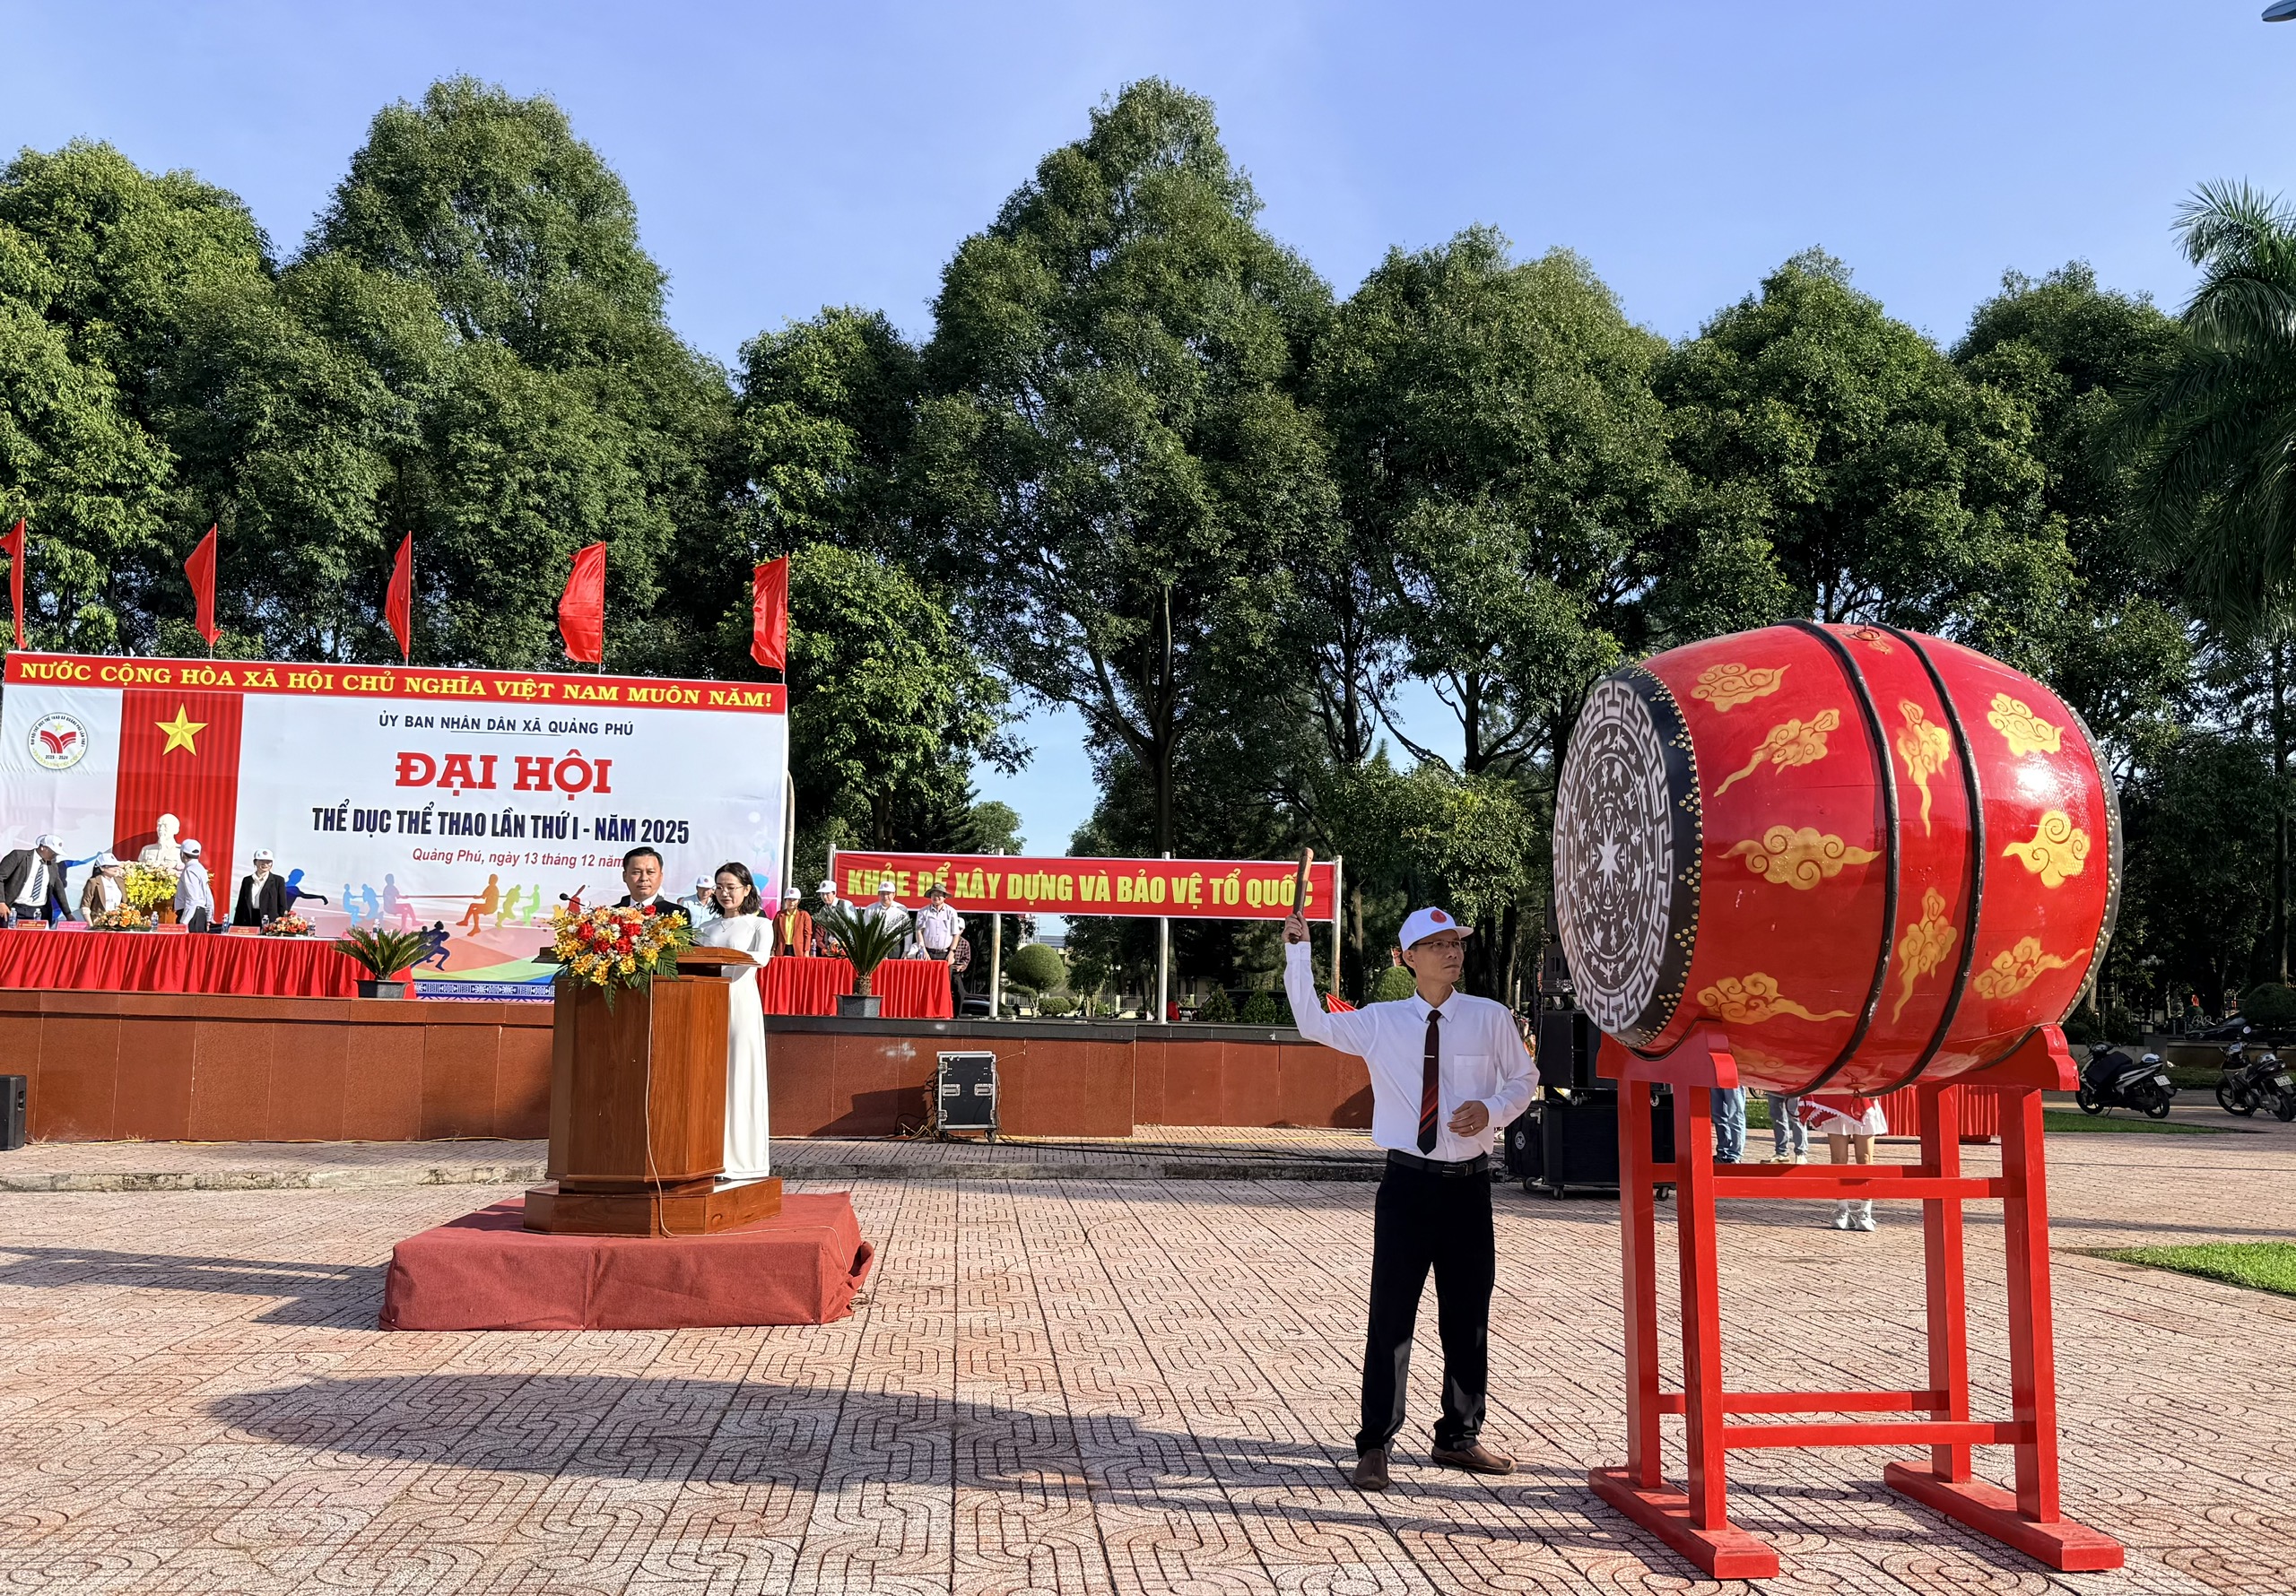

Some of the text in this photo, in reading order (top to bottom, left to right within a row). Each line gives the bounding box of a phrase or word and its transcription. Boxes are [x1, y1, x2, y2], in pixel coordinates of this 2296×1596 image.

[20, 660, 772, 707] NƯỚC CỘNG HÒA XÃ HỘI CHỦ NGHĨA VIỆT NAM MUÔN NĂM!
[378, 710, 634, 735] ỦY BAN NHÂN DÂN XÃ QUẢNG PHÚ
[395, 748, 613, 802] ĐẠI HỘI
[312, 798, 351, 832] THỂ
[352, 808, 392, 838] DỤC
[396, 801, 435, 835] THỂ
[438, 811, 487, 837] THAO
[491, 807, 526, 838] LẦN
[530, 811, 570, 840] THỨ
[572, 816, 578, 840] I
[594, 813, 637, 842] NĂM
[640, 819, 690, 845] 2025
[413, 847, 624, 869] Quảng Phú, ngày 13 tháng 12 năm
[954, 867, 1002, 899] XÂY
[1006, 869, 1074, 906] DỰNG
[1078, 869, 1111, 902] VÀ
[1117, 868, 1166, 904] BẢO
[1170, 872, 1204, 910] VỆ
[1209, 868, 1242, 906] TỔ
